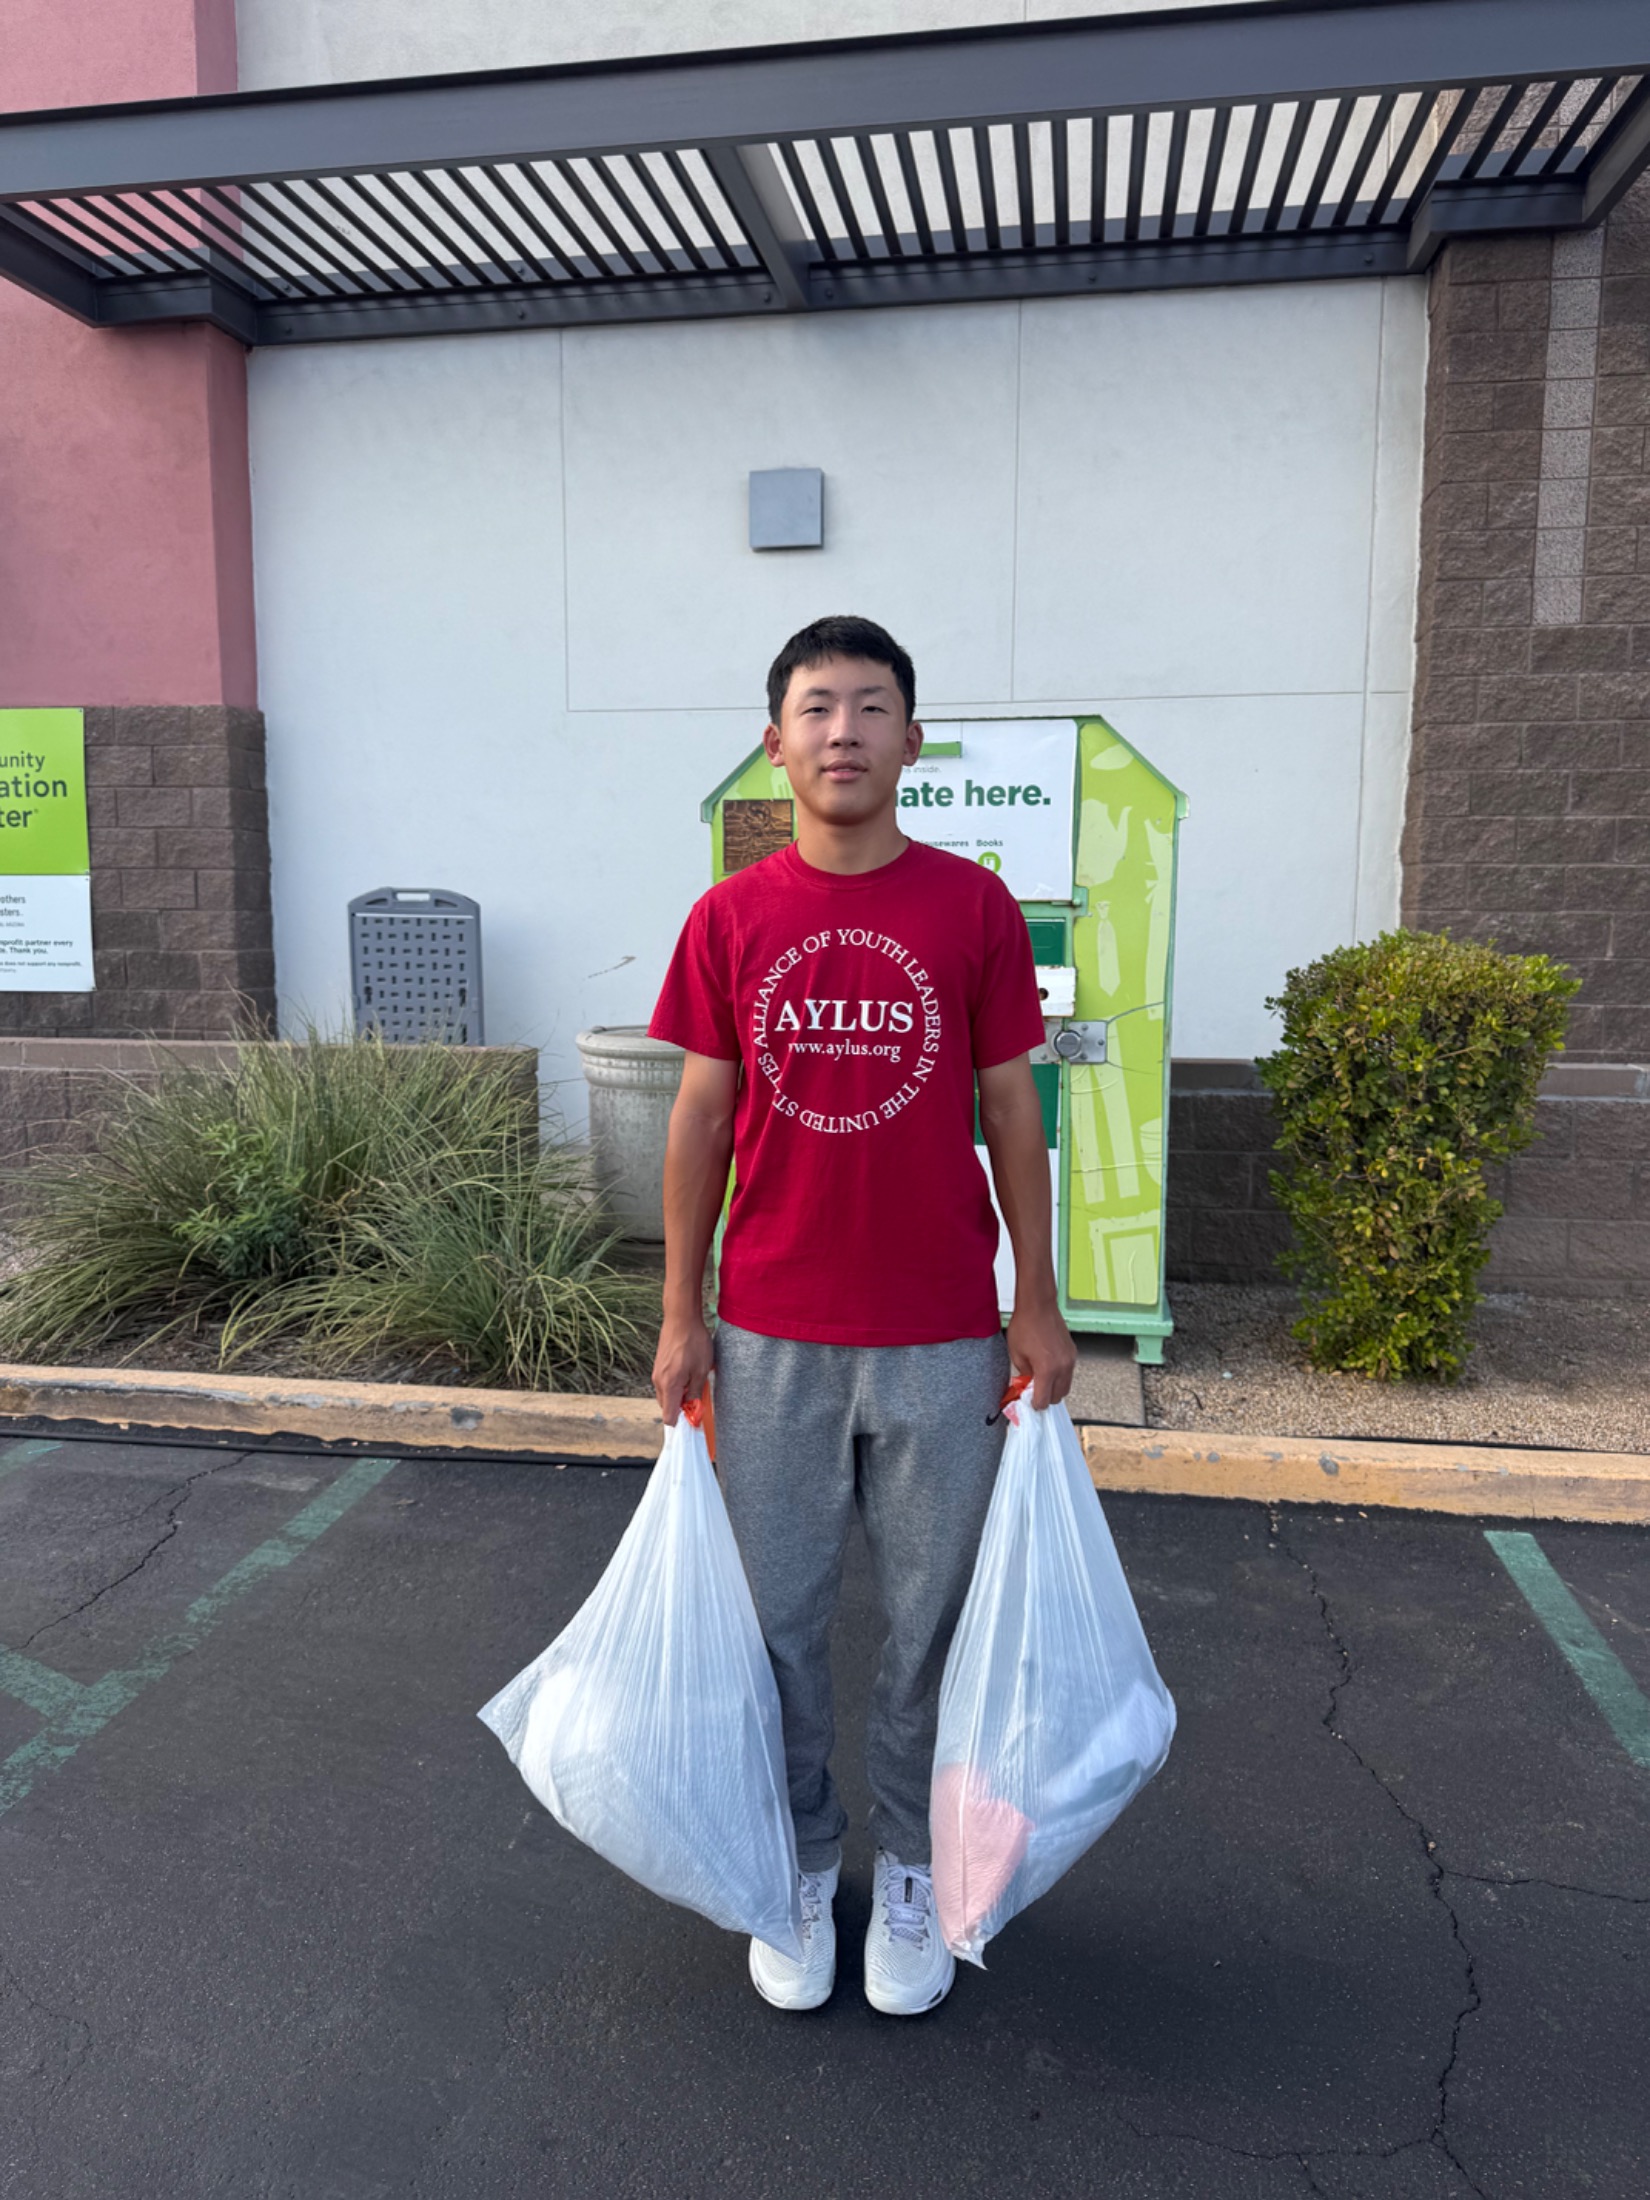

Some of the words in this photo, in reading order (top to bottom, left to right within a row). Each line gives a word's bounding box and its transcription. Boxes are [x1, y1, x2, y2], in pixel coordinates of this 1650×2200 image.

[896, 781, 954, 808] ate
[964, 779, 1051, 808] here.
[921, 839, 970, 847] ousewares
[975, 839, 1003, 847] Books
[9, 946, 31, 954] Thank
[802, 930, 831, 953] OF
[836, 928, 909, 964] YOUTH
[753, 947, 802, 1048] ALLIANCE
[903, 957, 942, 1053] LEADERS
[774, 998, 914, 1034] AYLUS
[757, 1052, 799, 1117] STTES
[912, 1055, 936, 1083] IN
[879, 1082, 920, 1120] THE
[799, 1109, 881, 1134] UNITED
